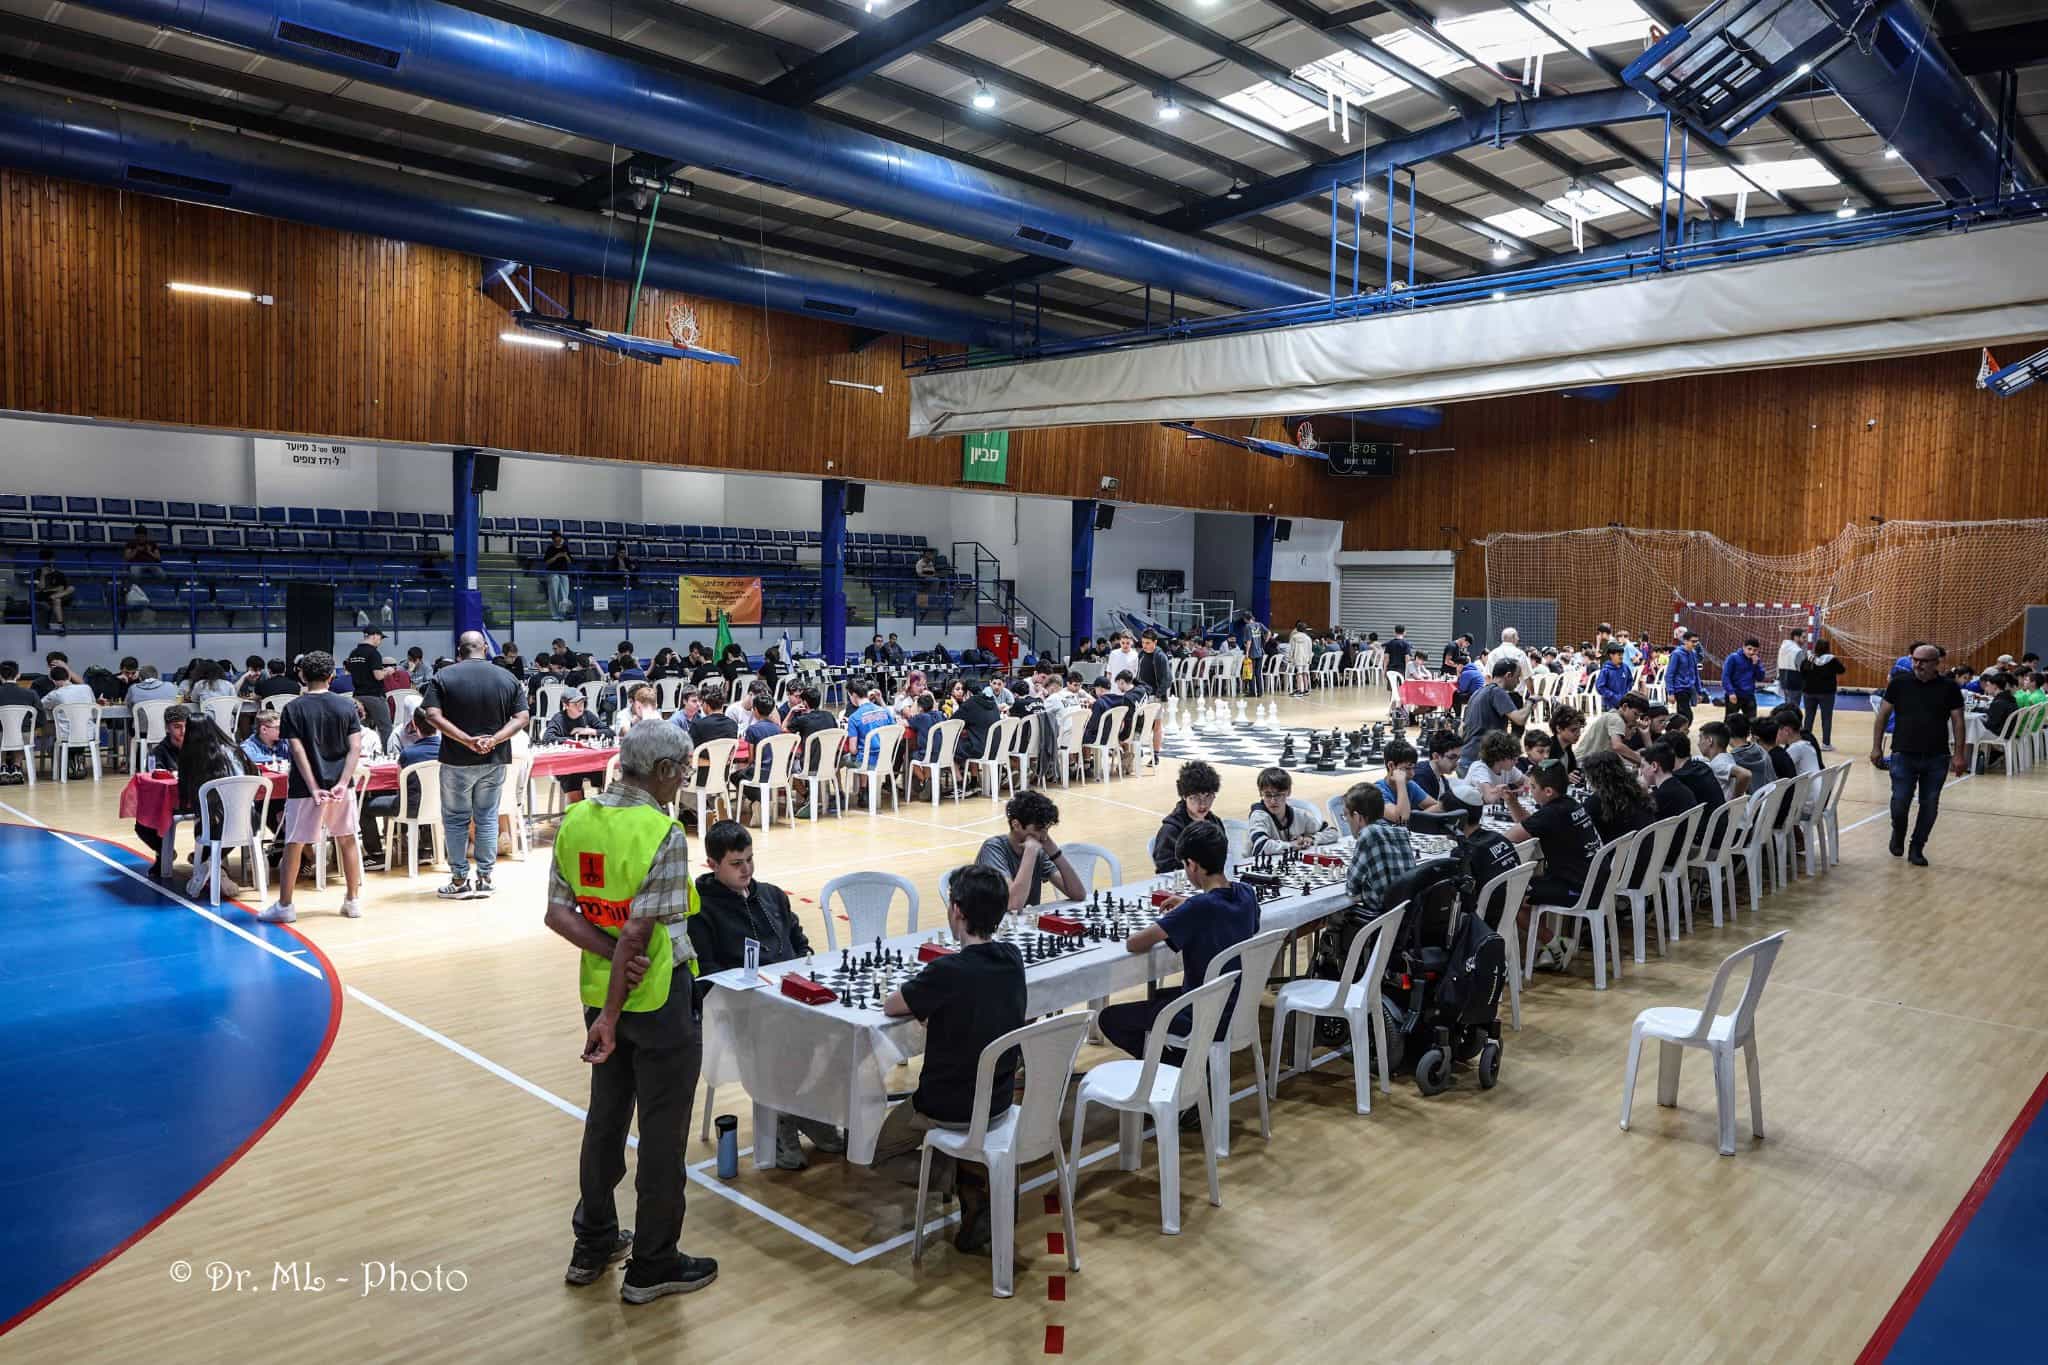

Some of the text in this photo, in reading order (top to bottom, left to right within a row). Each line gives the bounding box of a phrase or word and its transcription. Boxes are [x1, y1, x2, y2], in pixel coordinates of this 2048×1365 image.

[286, 442, 309, 451] מיועד
[292, 456, 317, 464] צופים
[970, 447, 1000, 465] סביון
